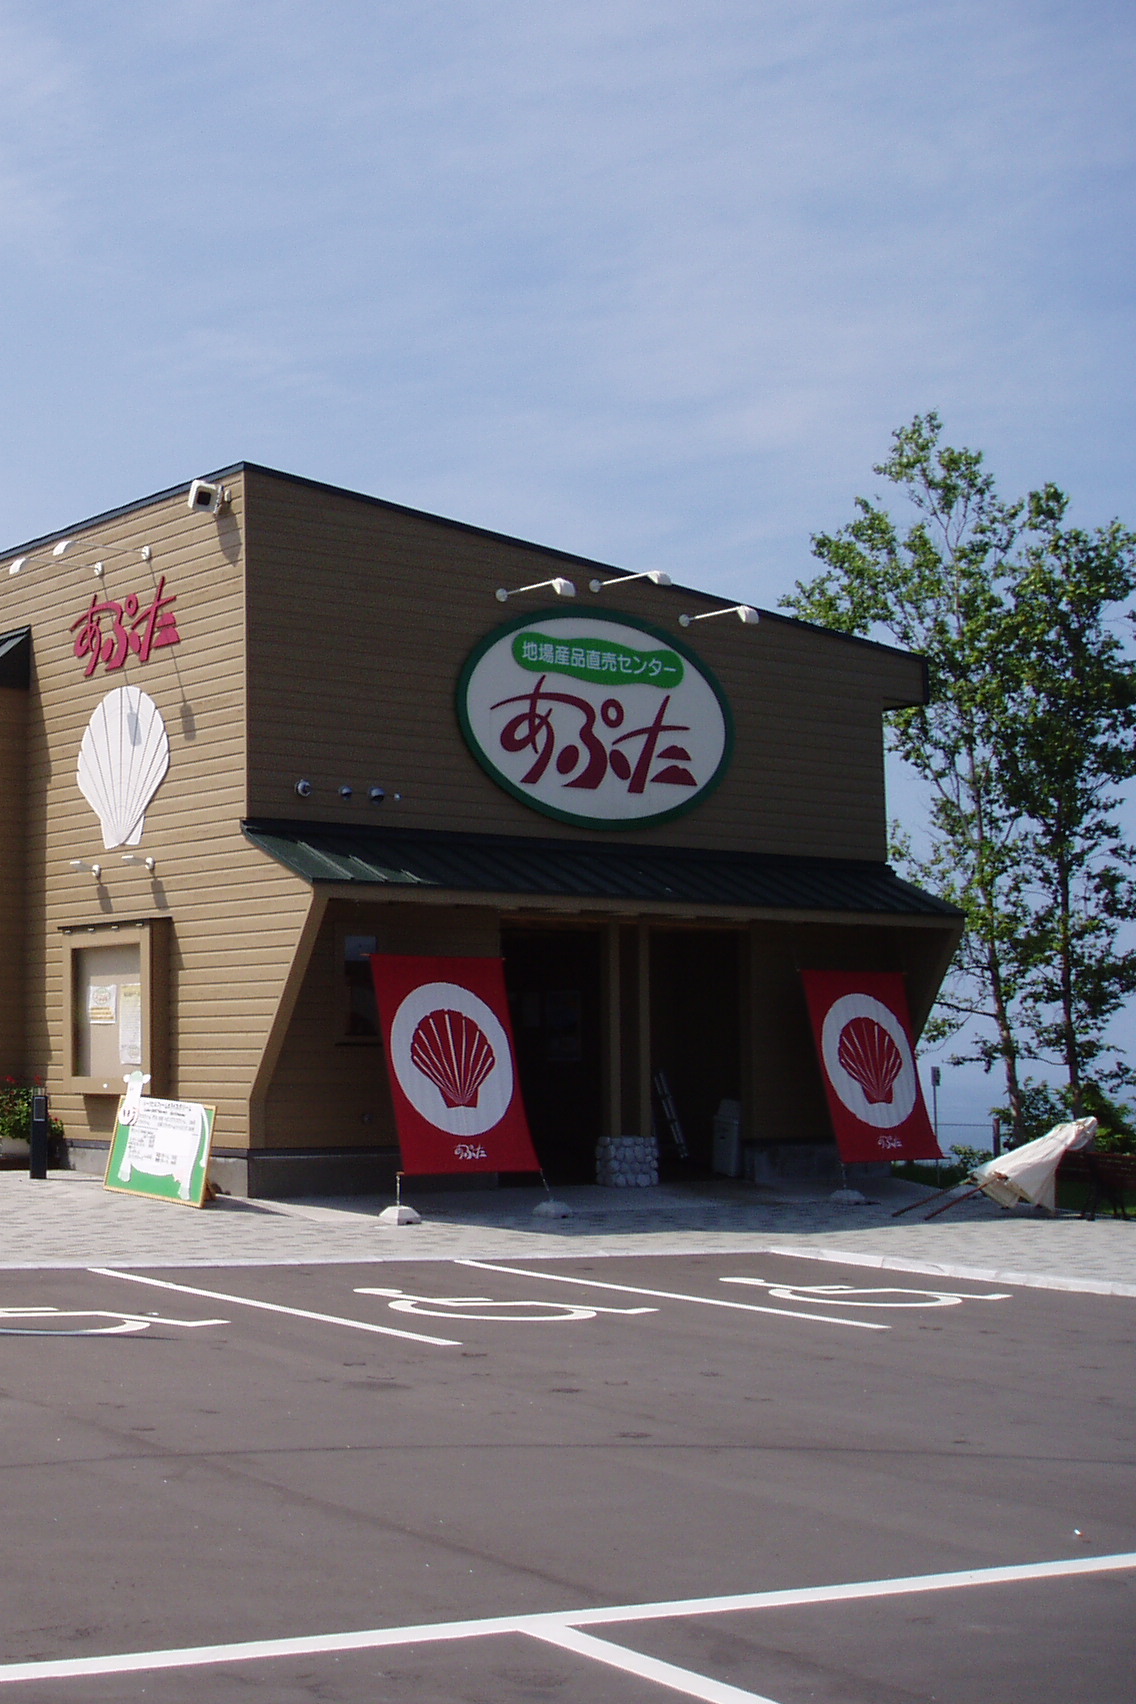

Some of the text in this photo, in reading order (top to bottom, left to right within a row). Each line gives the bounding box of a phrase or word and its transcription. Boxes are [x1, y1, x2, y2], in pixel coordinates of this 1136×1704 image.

[69, 575, 182, 678] あぷた
[521, 641, 677, 678] 地場産品直売センター
[489, 674, 699, 794] あぷた
